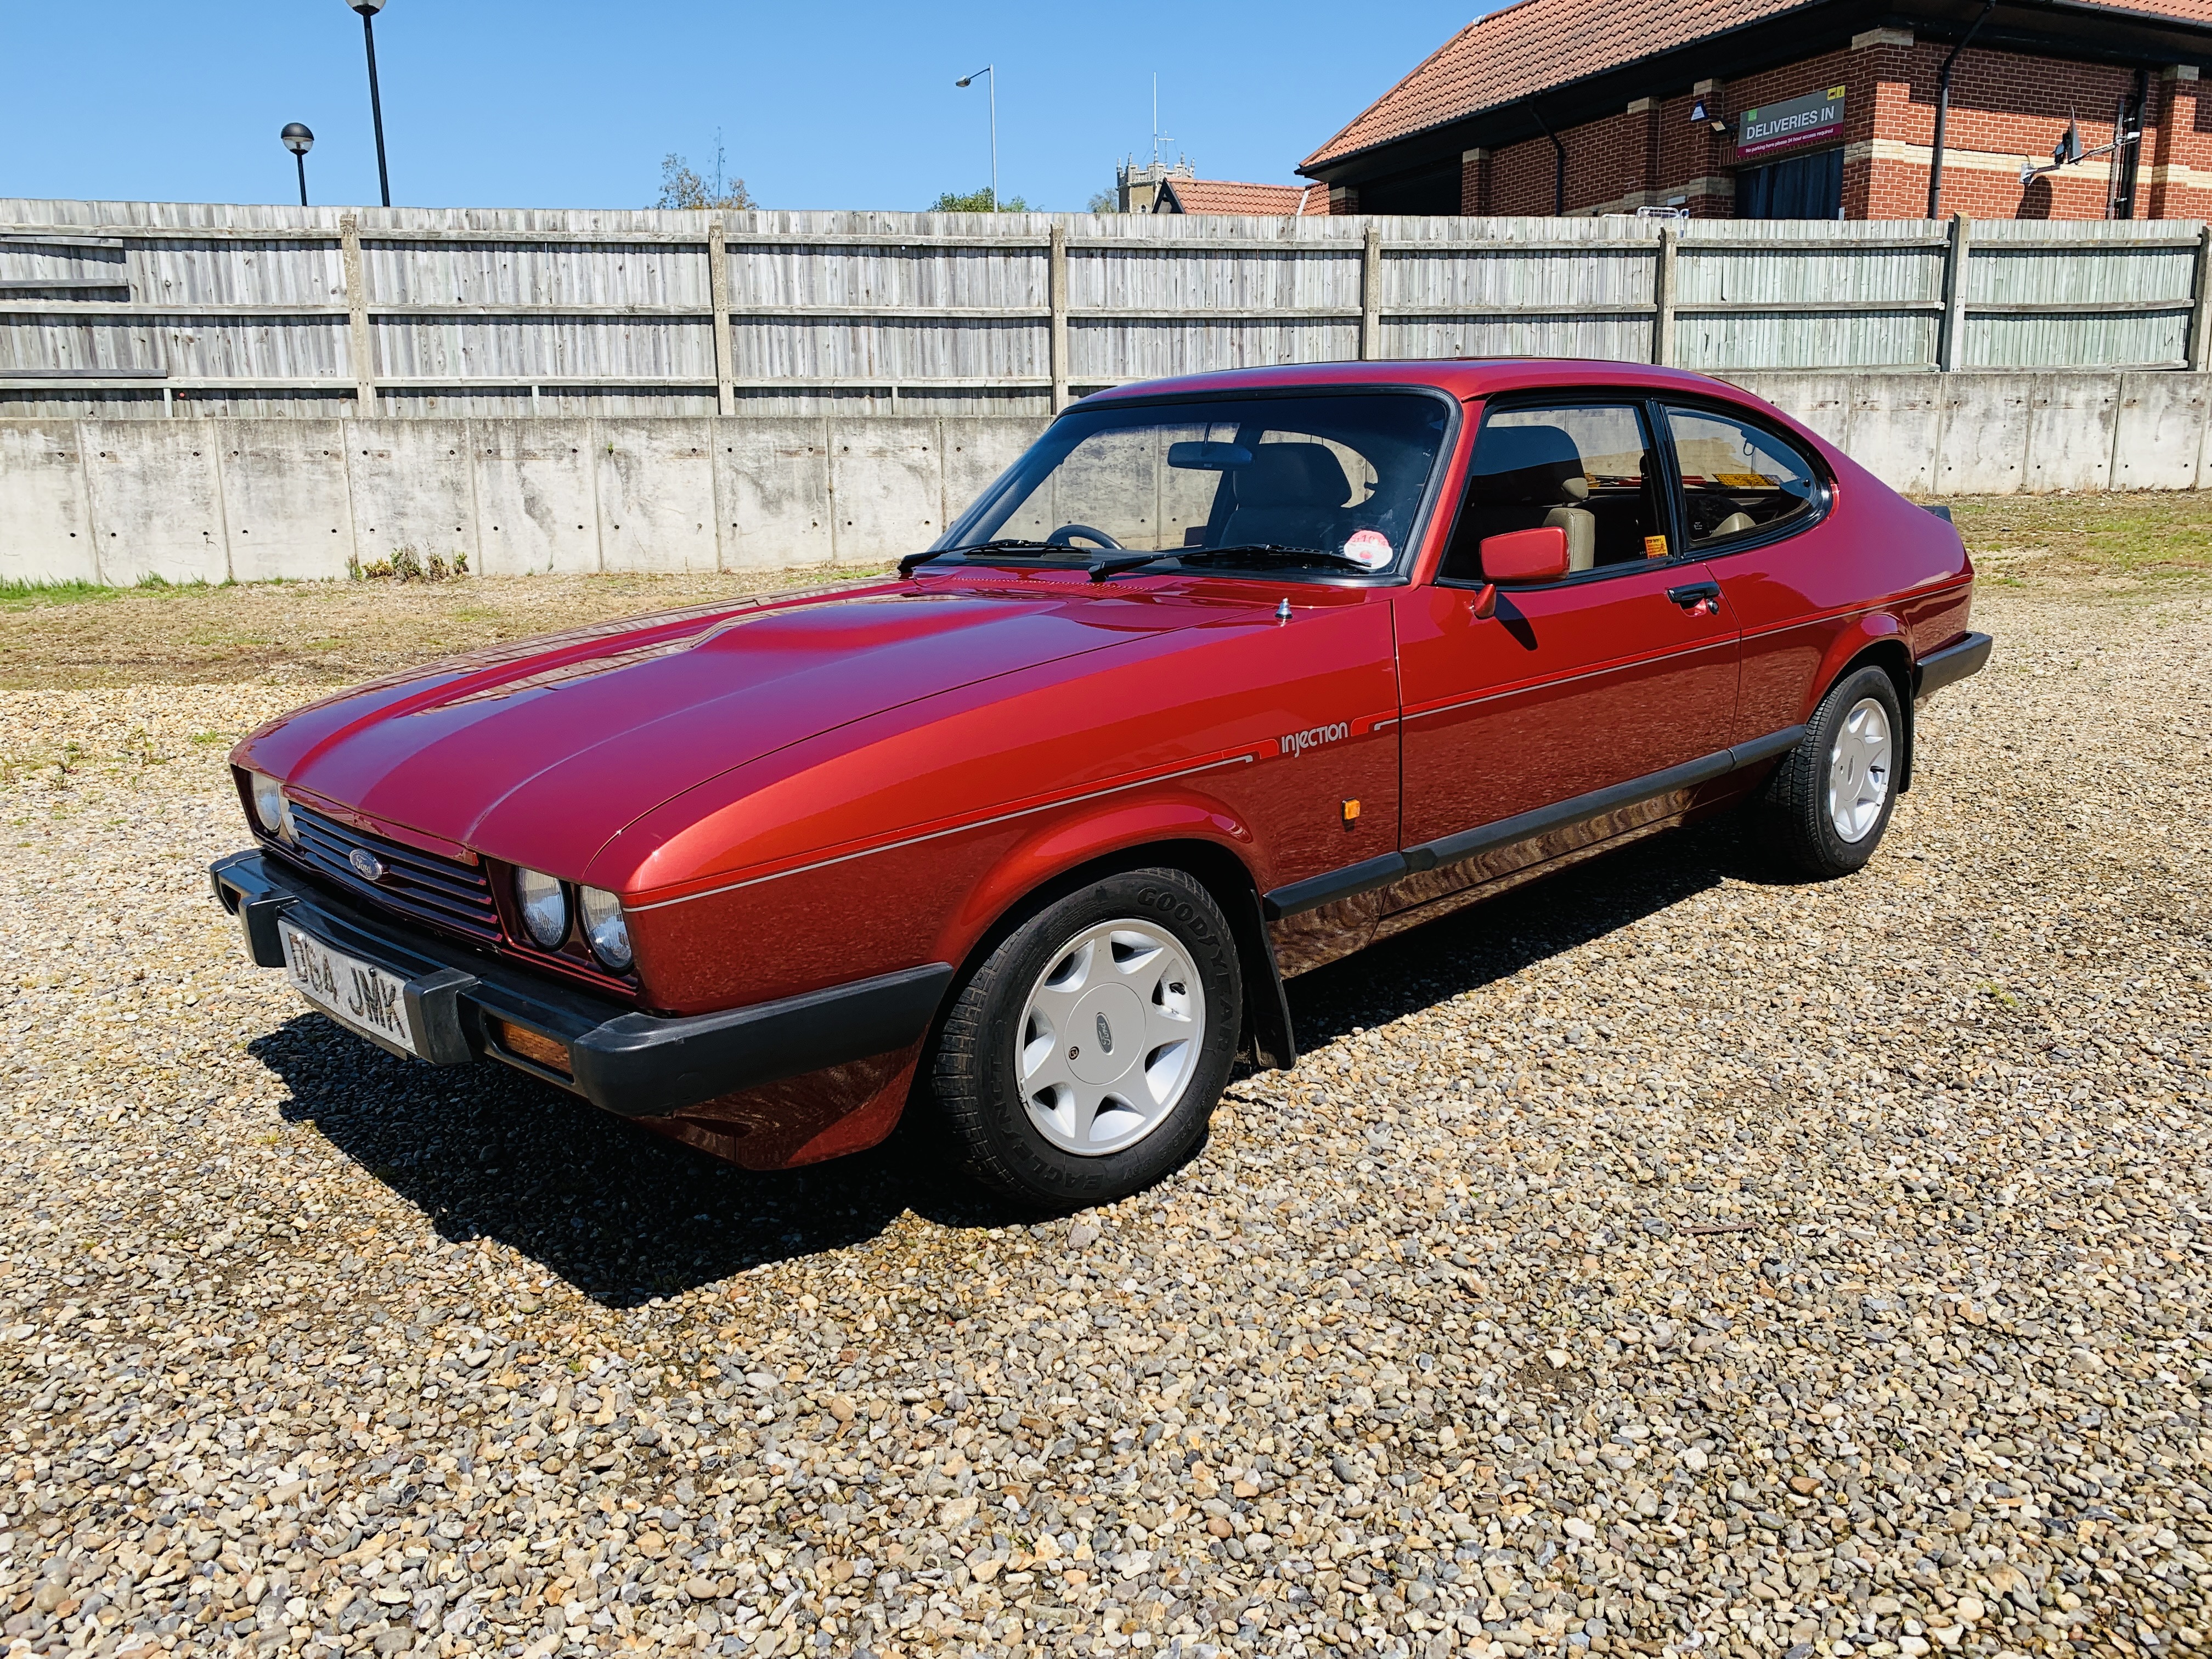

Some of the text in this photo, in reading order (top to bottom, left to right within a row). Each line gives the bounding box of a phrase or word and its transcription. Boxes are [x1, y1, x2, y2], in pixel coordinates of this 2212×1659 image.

[1746, 105, 1835, 140] DELIVERIES IN
[1752, 144, 1766, 153] parking
[1816, 127, 1834, 137] required
[1137, 887, 1234, 1052] GOODYEAR
[347, 966, 406, 1039] JMK
[1098, 1022, 1111, 1045] Ford
[1013, 1141, 1104, 1190] EAGLE
